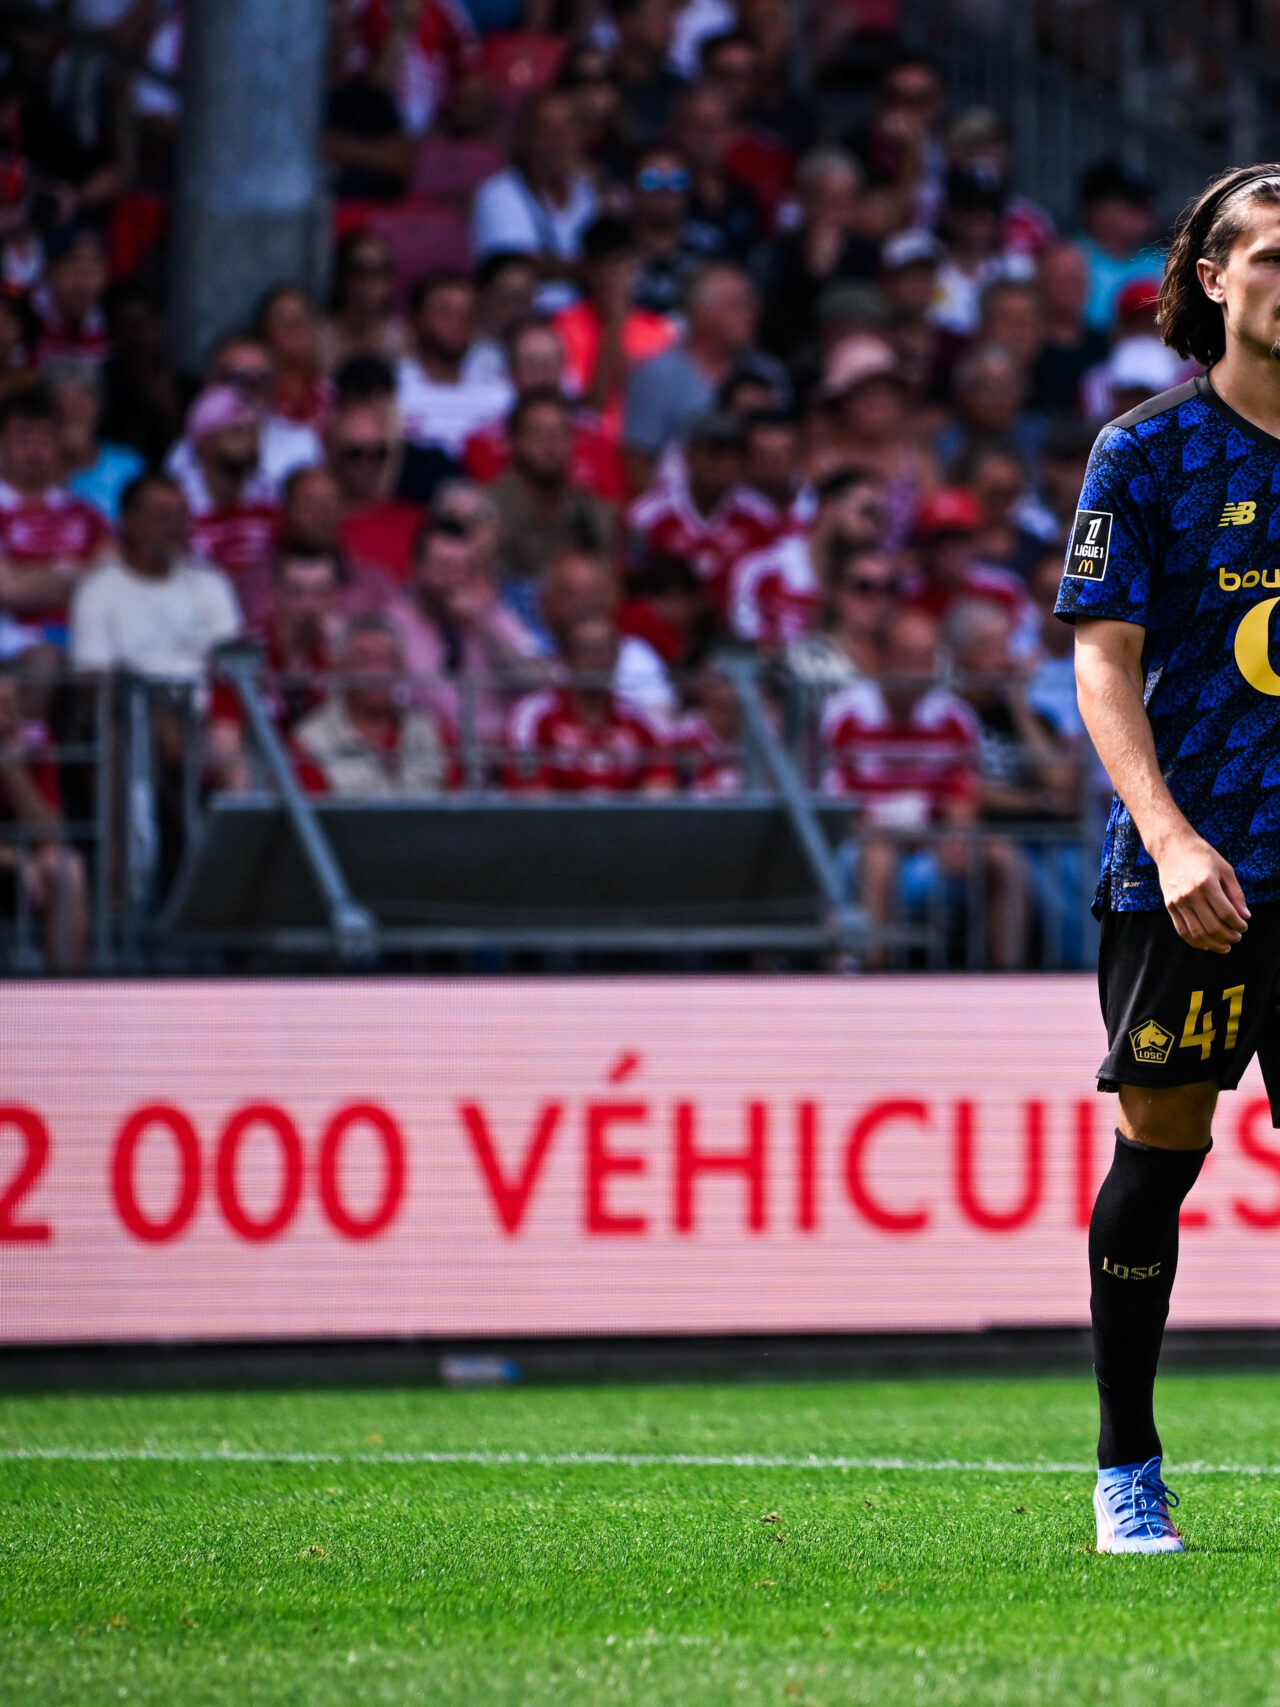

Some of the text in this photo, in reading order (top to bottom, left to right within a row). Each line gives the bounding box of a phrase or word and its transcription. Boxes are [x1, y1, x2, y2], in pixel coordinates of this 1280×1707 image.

[1179, 984, 1245, 1061] 41
[1138, 1050, 1163, 1060] LOSC
[110, 1100, 408, 1243] 000
[1101, 1257, 1161, 1280] LOSC
